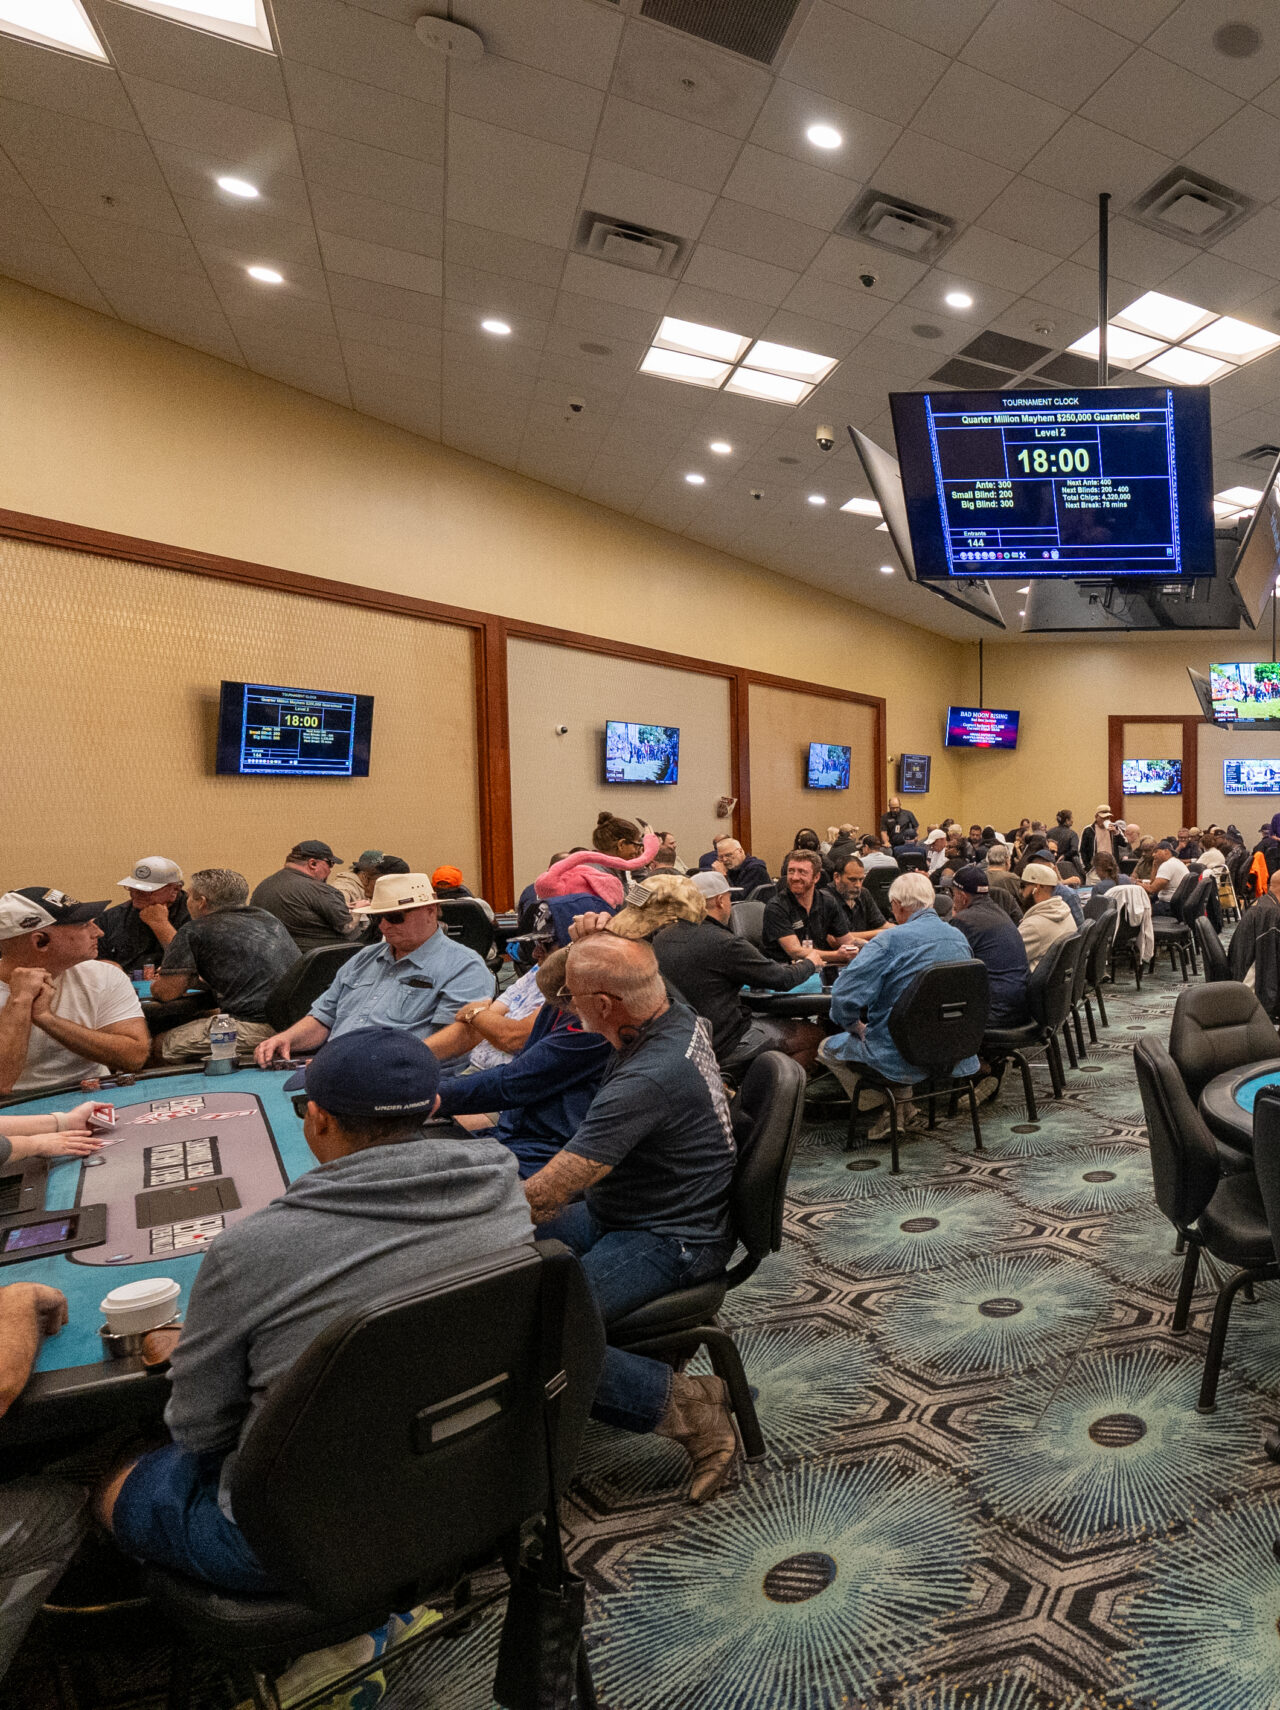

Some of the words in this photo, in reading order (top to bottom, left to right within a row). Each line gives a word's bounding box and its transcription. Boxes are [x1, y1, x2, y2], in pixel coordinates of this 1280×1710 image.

[962, 416, 991, 424] Quarter
[994, 415, 1018, 423] Million
[1022, 414, 1054, 424] Mayhem
[1057, 413, 1091, 422] $250,000
[1094, 413, 1140, 421] Guaranteed
[1035, 428, 1058, 437] Level
[1060, 428, 1066, 436] 2
[1018, 448, 1089, 473] 18:00
[952, 491, 973, 499] Small
[962, 501, 974, 509] Big
[976, 500, 998, 508] Blind:
[968, 539, 984, 547] 144
[285, 715, 318, 727] 18:00
